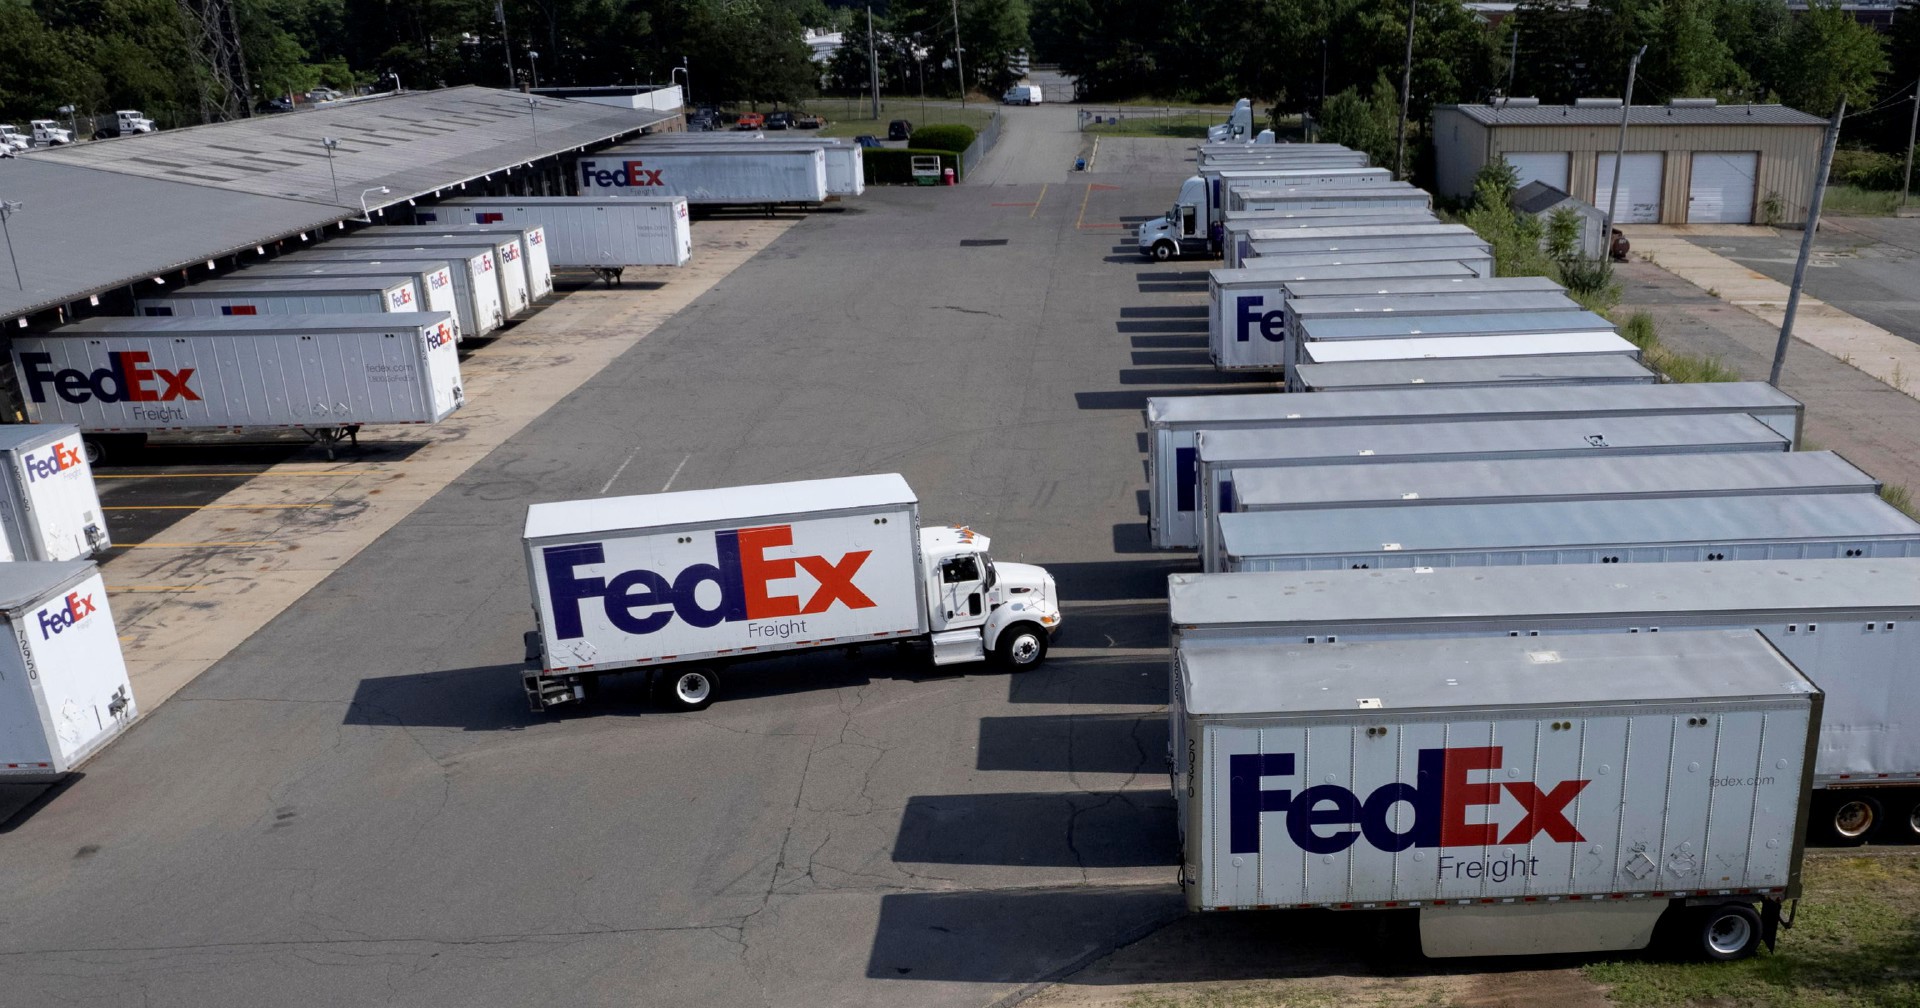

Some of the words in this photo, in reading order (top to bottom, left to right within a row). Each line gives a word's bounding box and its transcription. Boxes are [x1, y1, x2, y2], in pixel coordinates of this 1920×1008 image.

[581, 161, 664, 187] FedEx
[529, 231, 543, 247] FedEx
[473, 254, 493, 277] FedEx
[501, 244, 520, 264] FedEx
[430, 271, 448, 291] FedEx
[391, 288, 411, 308] FedEx
[425, 323, 452, 352] FedEx
[20, 351, 203, 404] FedEx
[366, 363, 414, 373] fedex.com
[133, 406, 184, 423] Freight
[25, 442, 81, 483] FedEx
[543, 524, 878, 640] FedEx
[37, 591, 96, 641] FedEx
[748, 619, 807, 639] Freight
[17, 630, 37, 680] 72950
[1709, 775, 1775, 787] fedex.com
[1230, 745, 1592, 854] FedEx
[1438, 854, 1539, 883] Freight
